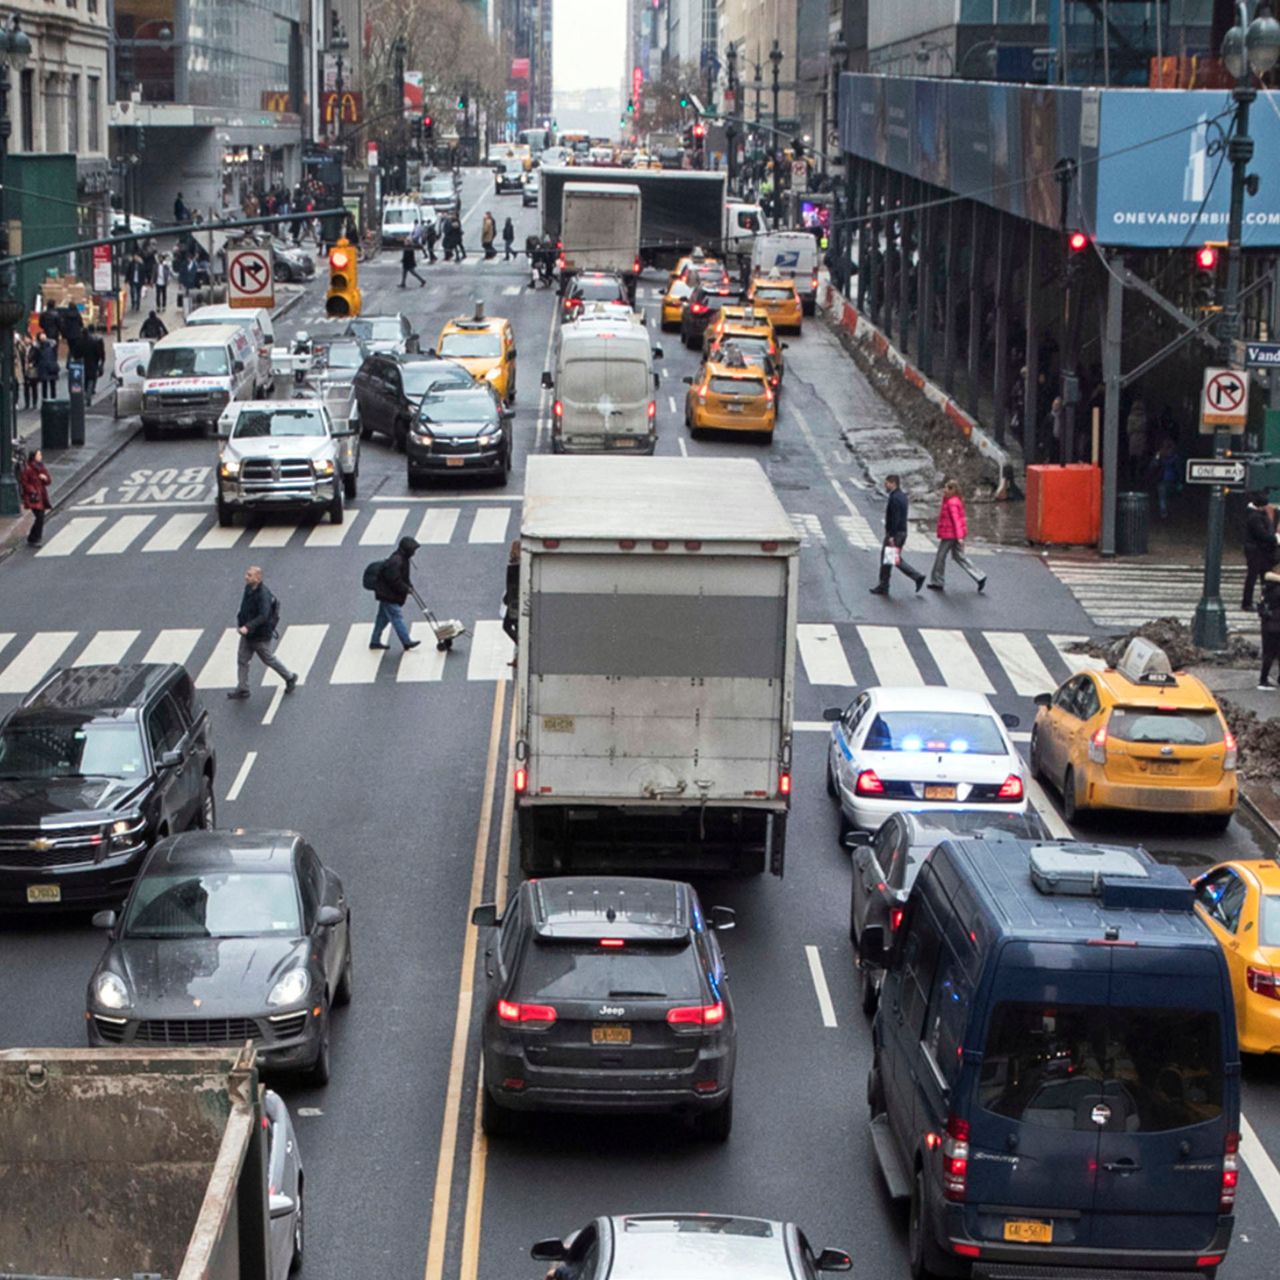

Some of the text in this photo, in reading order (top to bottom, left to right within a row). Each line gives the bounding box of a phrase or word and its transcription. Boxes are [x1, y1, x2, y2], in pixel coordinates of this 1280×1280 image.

[1197, 465, 1243, 476] ONE WAY
[599, 1005, 625, 1017] Jeep
